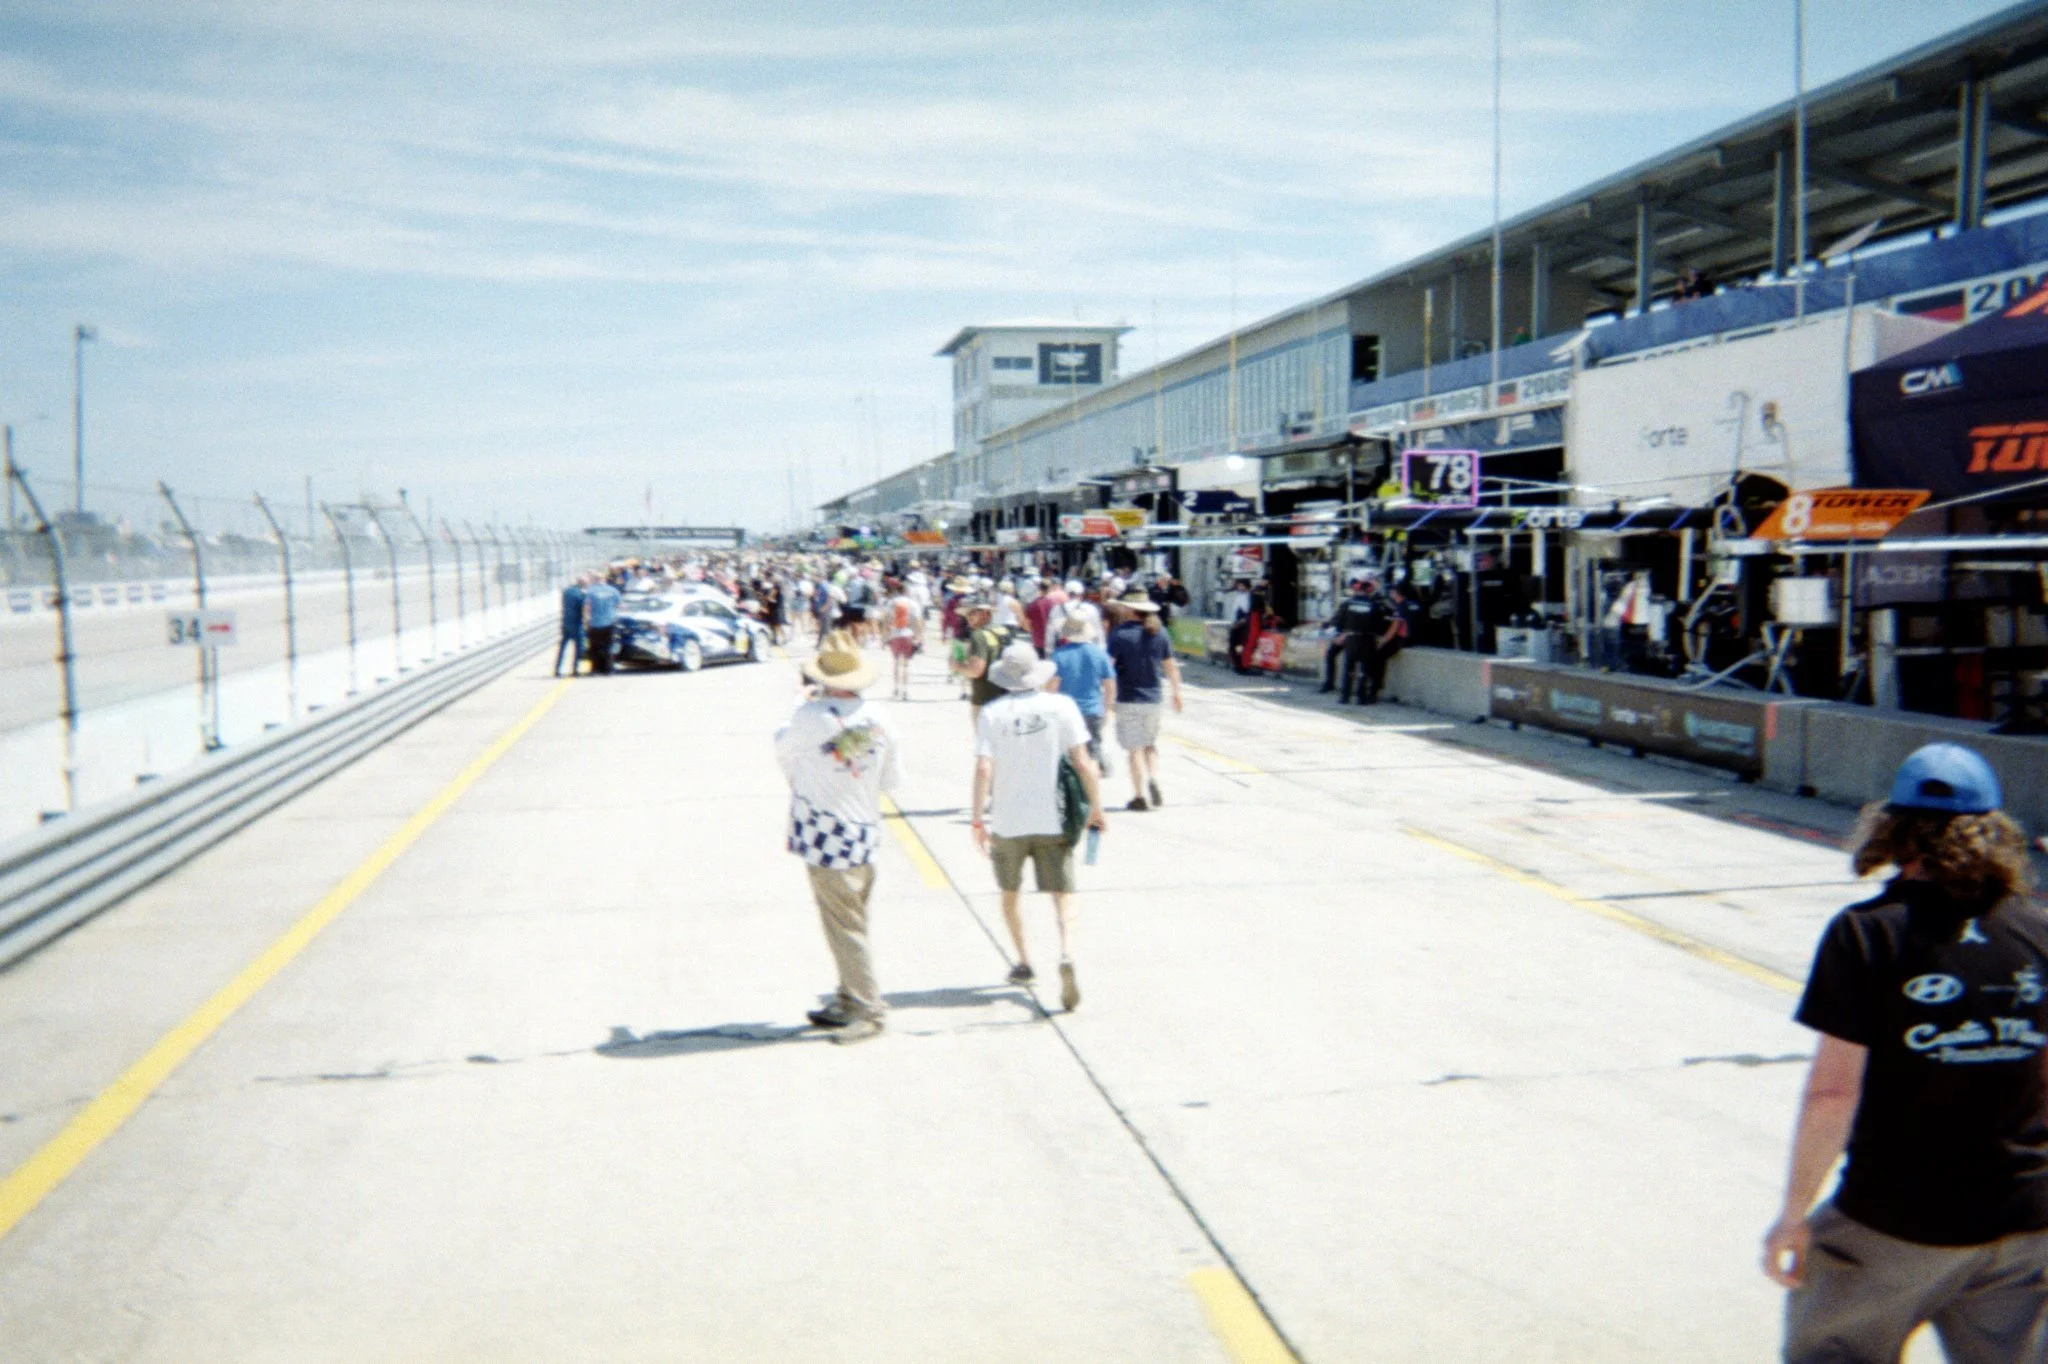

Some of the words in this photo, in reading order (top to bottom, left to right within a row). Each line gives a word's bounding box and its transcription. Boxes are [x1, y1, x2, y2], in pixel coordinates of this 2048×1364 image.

[1424, 455, 1473, 489] 78
[1782, 493, 1814, 535] 8
[1811, 493, 1918, 509] TOWER
[168, 618, 202, 646] 34
